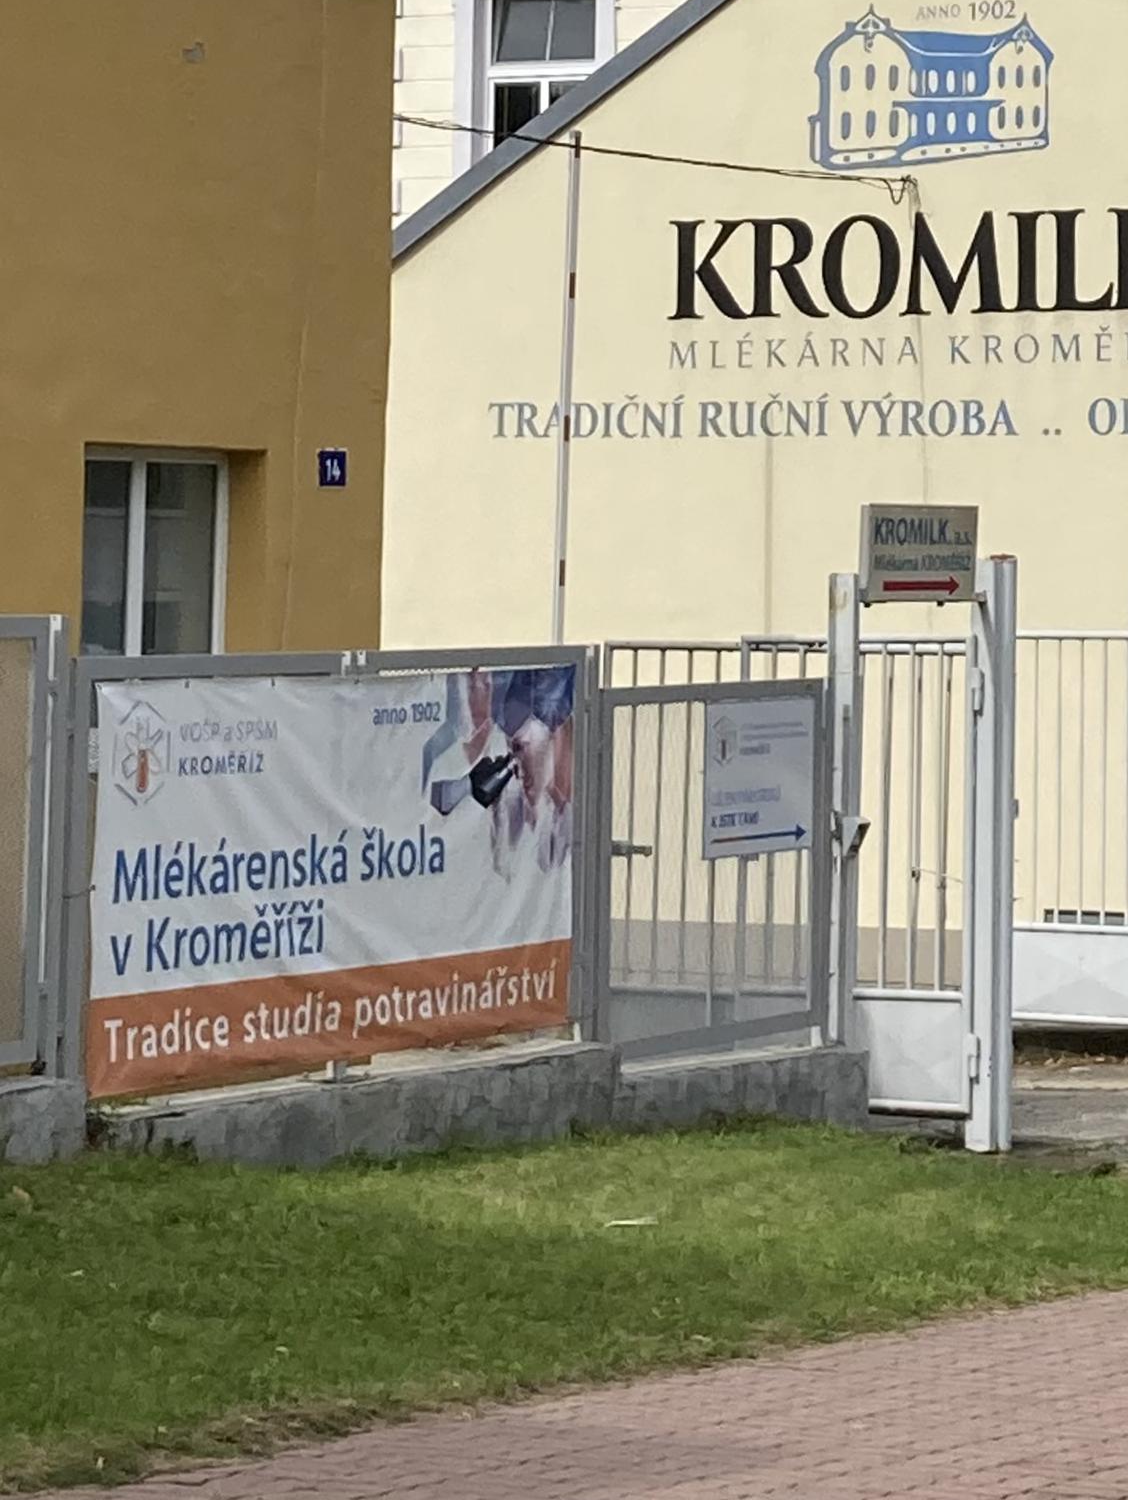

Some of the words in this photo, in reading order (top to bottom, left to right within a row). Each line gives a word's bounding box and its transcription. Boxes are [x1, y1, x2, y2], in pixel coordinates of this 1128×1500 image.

[916, 3, 961, 21] ANNO
[968, 0, 1017, 21] 1902
[669, 331, 919, 370] MLÉKÁRNA
[488, 394, 685, 439] TRADIČNÍ
[698, 393, 829, 438] RUČNÍ
[840, 392, 1019, 438] VÝROBA
[325, 458, 341, 481] 14
[223, 724, 233, 742] a
[372, 707, 407, 726] anno
[411, 701, 441, 723] 1902
[112, 830, 347, 904] Mlékárenská
[360, 824, 445, 881] škola
[110, 934, 132, 976] v
[146, 898, 324, 972] Kroměříži
[104, 1007, 229, 1063] Tradice
[243, 990, 341, 1044] studia
[352, 958, 557, 1039] potravinářství
